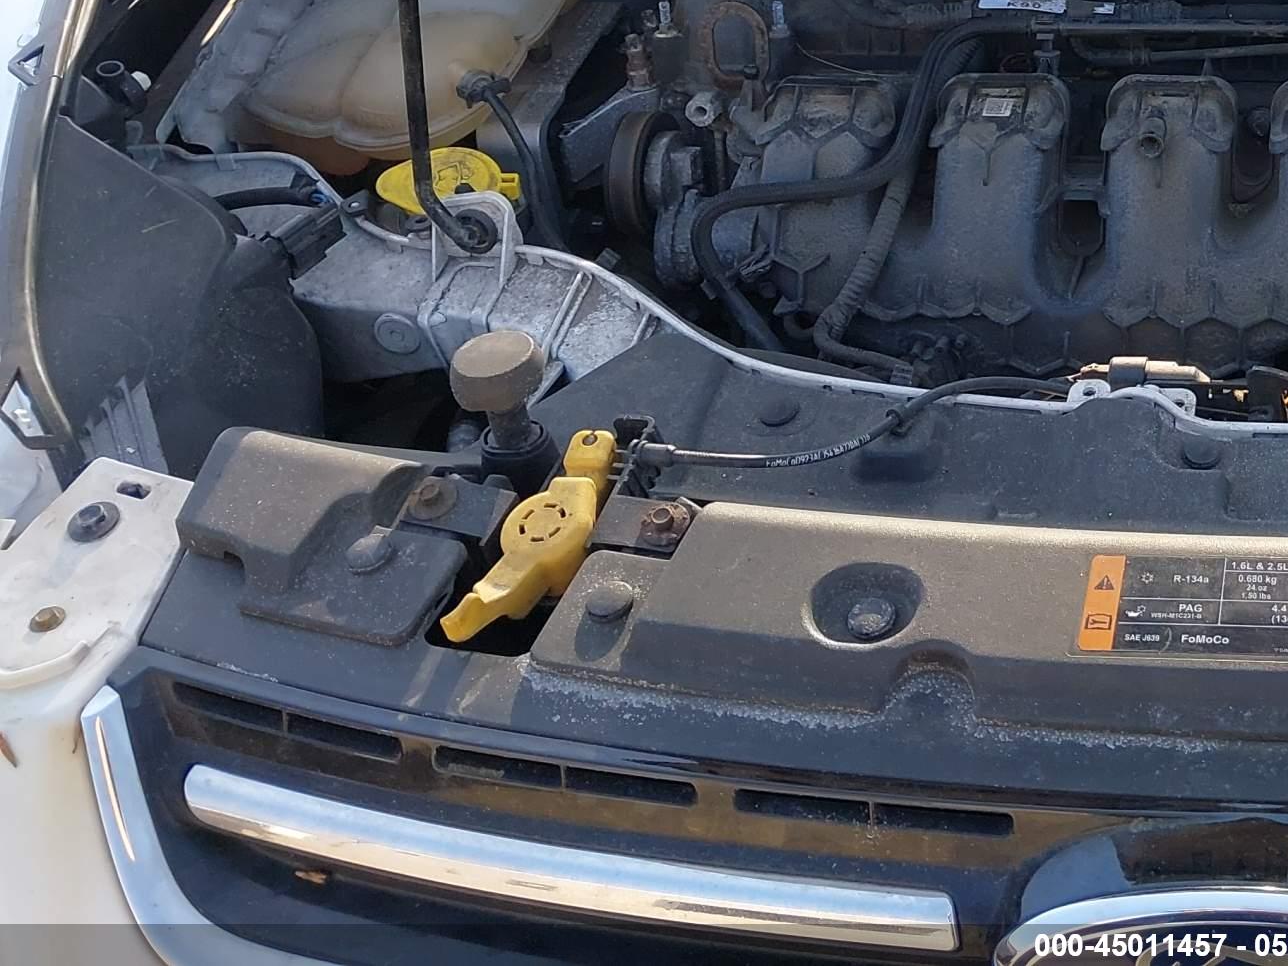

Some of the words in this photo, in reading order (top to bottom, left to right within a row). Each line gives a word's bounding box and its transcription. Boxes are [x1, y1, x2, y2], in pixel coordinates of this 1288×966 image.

[1231, 561, 1254, 570] 1.6L
[1256, 562, 1264, 570] &
[1267, 562, 1288, 571] 2.5L
[1173, 574, 1209, 583] R-134a
[1238, 574, 1262, 583] 0.680
[1265, 575, 1277, 585] kg
[1241, 592, 1257, 600] 1.50
[1259, 592, 1271, 600] lbs
[1178, 604, 1203, 612] PAG
[1271, 604, 1287, 613] 4.4
[1124, 633, 1141, 641] SAE
[1142, 634, 1160, 642] J639
[1180, 634, 1230, 644] FoMoCo
